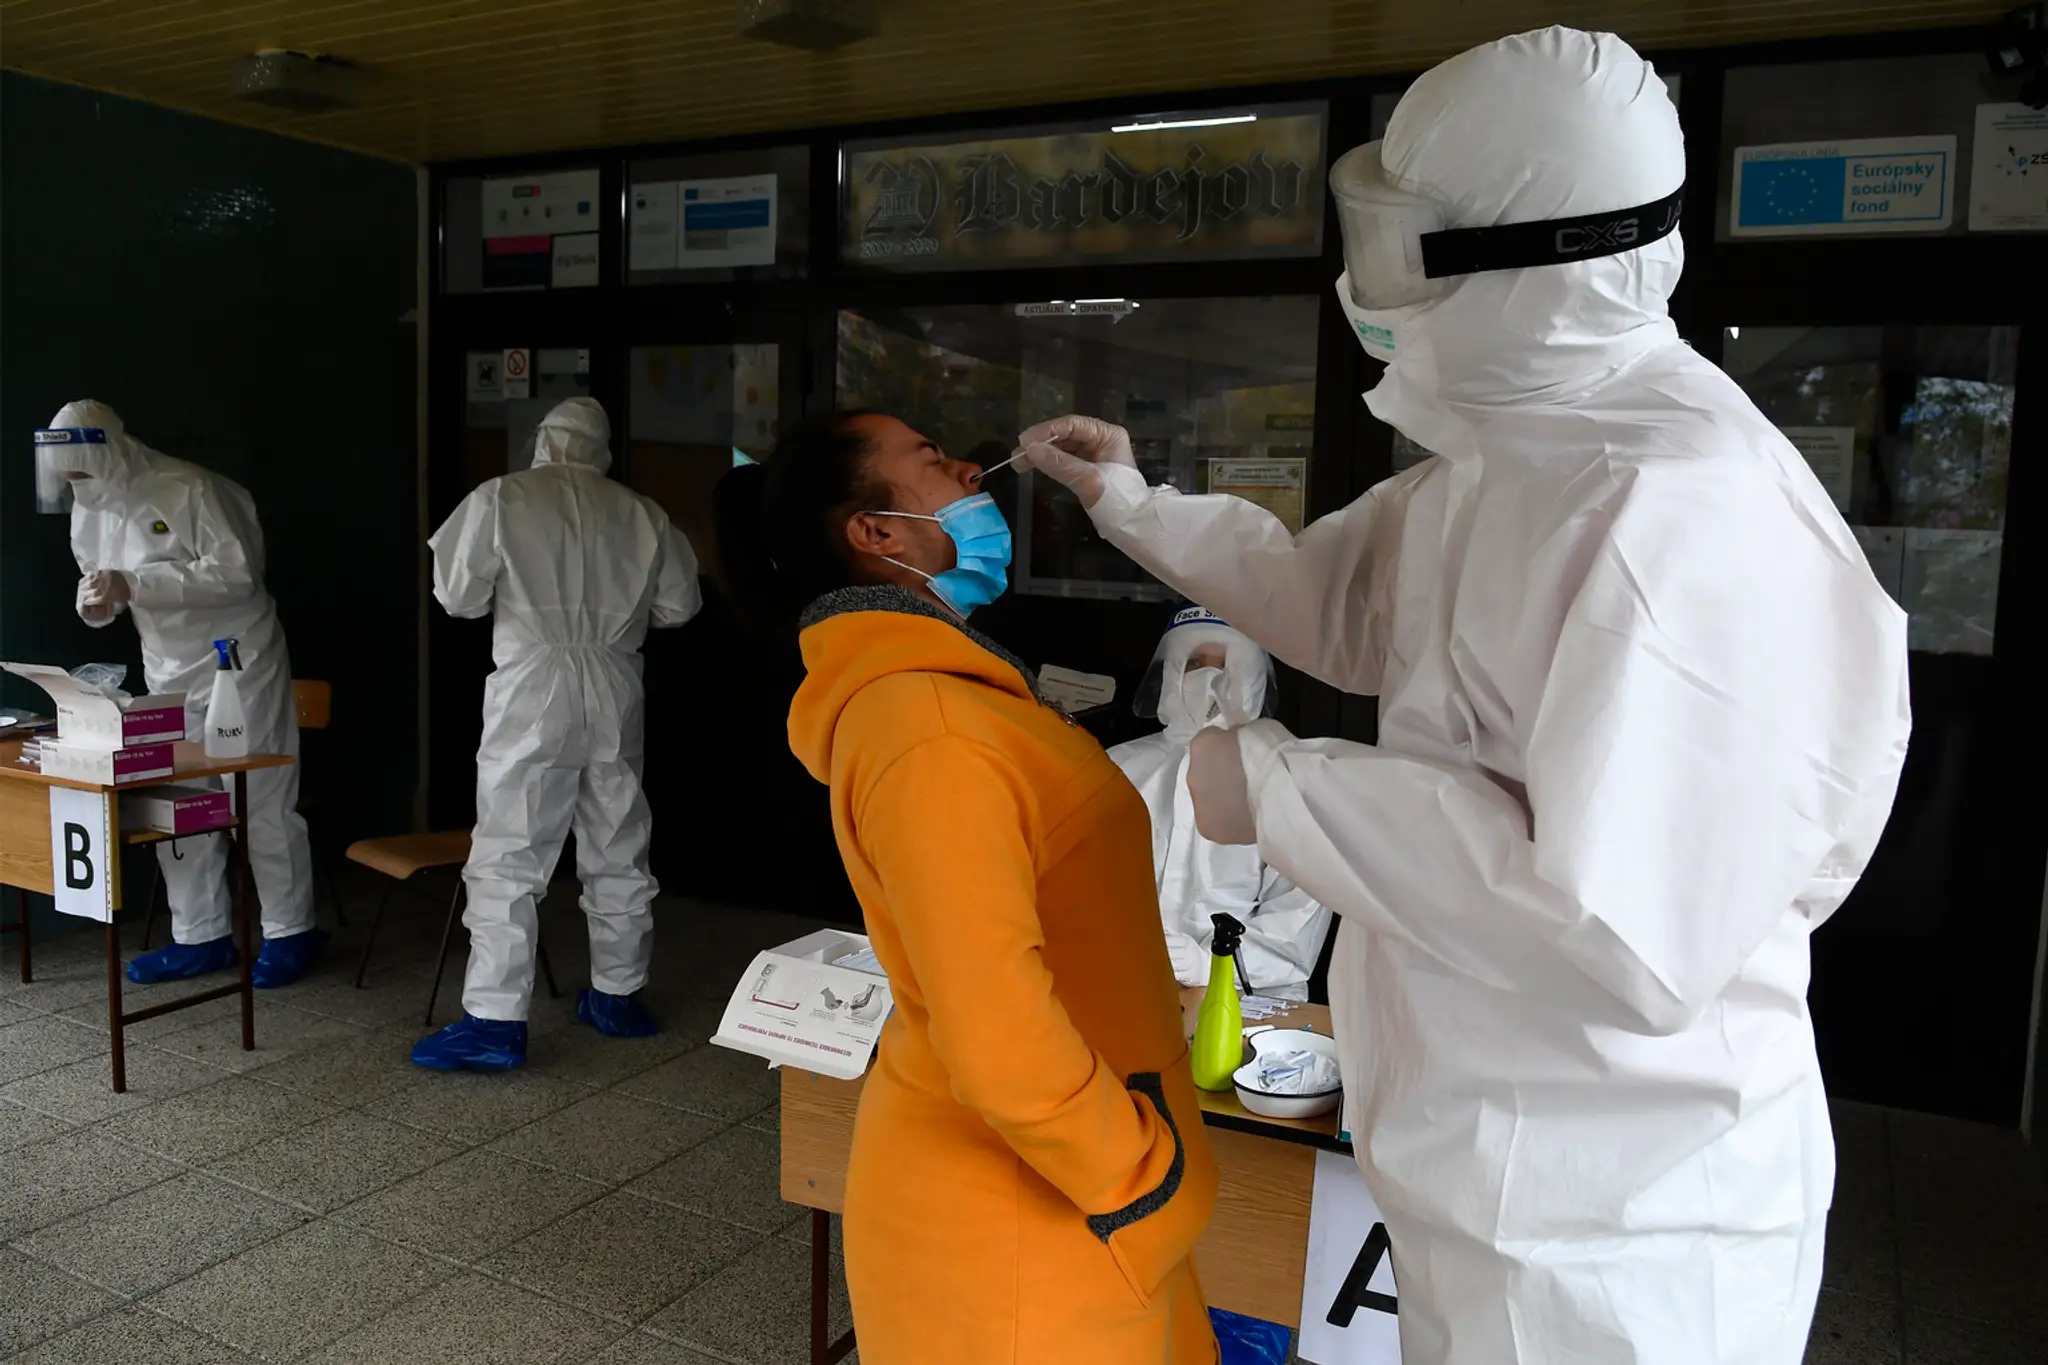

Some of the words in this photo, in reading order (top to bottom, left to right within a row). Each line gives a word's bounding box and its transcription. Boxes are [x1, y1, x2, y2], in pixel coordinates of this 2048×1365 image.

[1853, 161, 1935, 179] Európsky
[954, 144, 1304, 243] Bardejov
[1851, 179, 1924, 198] sociálny
[1850, 200, 1890, 214] fond
[1555, 218, 1639, 253] CXS
[1176, 609, 1200, 622] Face
[64, 821, 95, 890] B
[1326, 1221, 1399, 1329] A
